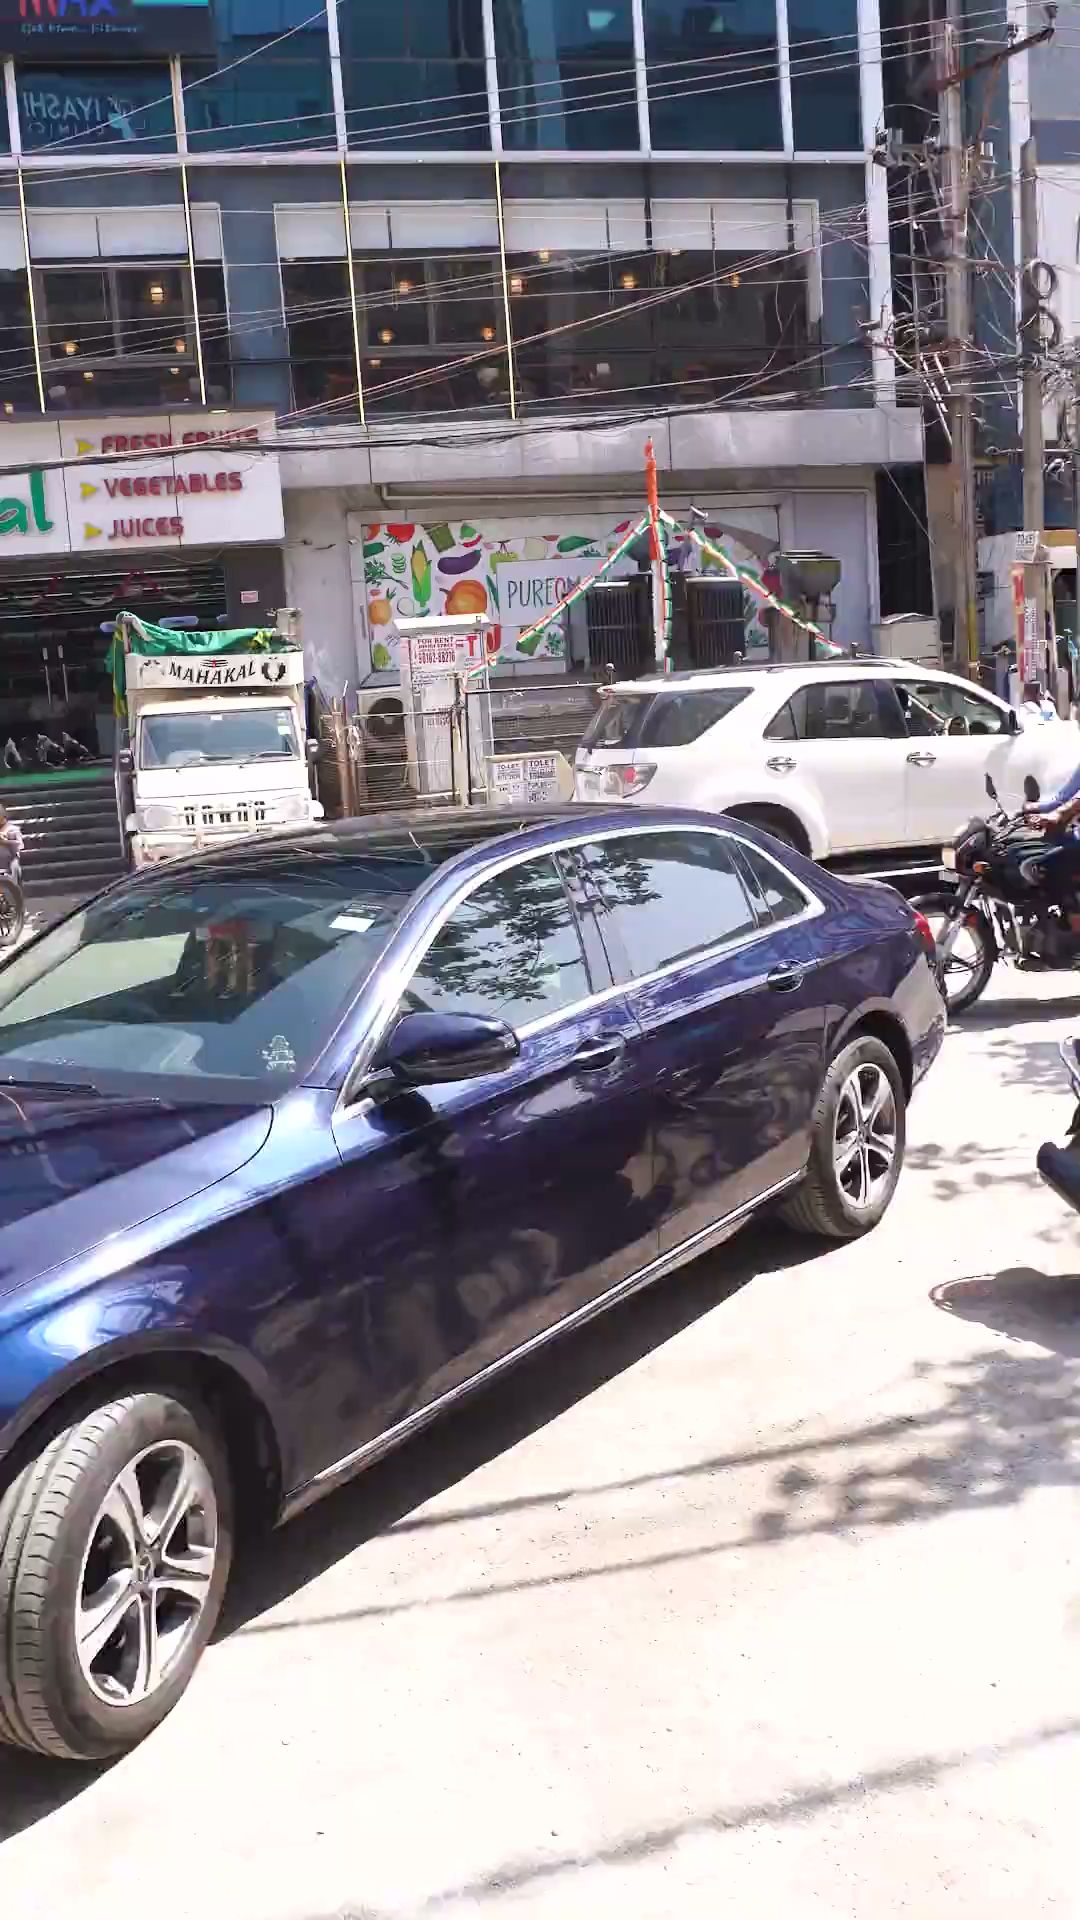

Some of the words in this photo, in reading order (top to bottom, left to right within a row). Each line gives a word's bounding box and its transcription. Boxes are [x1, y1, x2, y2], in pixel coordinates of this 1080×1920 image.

[104, 471, 242, 497] VEGETABLES
[108, 516, 184, 539] JUICES
[169, 660, 256, 685] MAHAKAL
